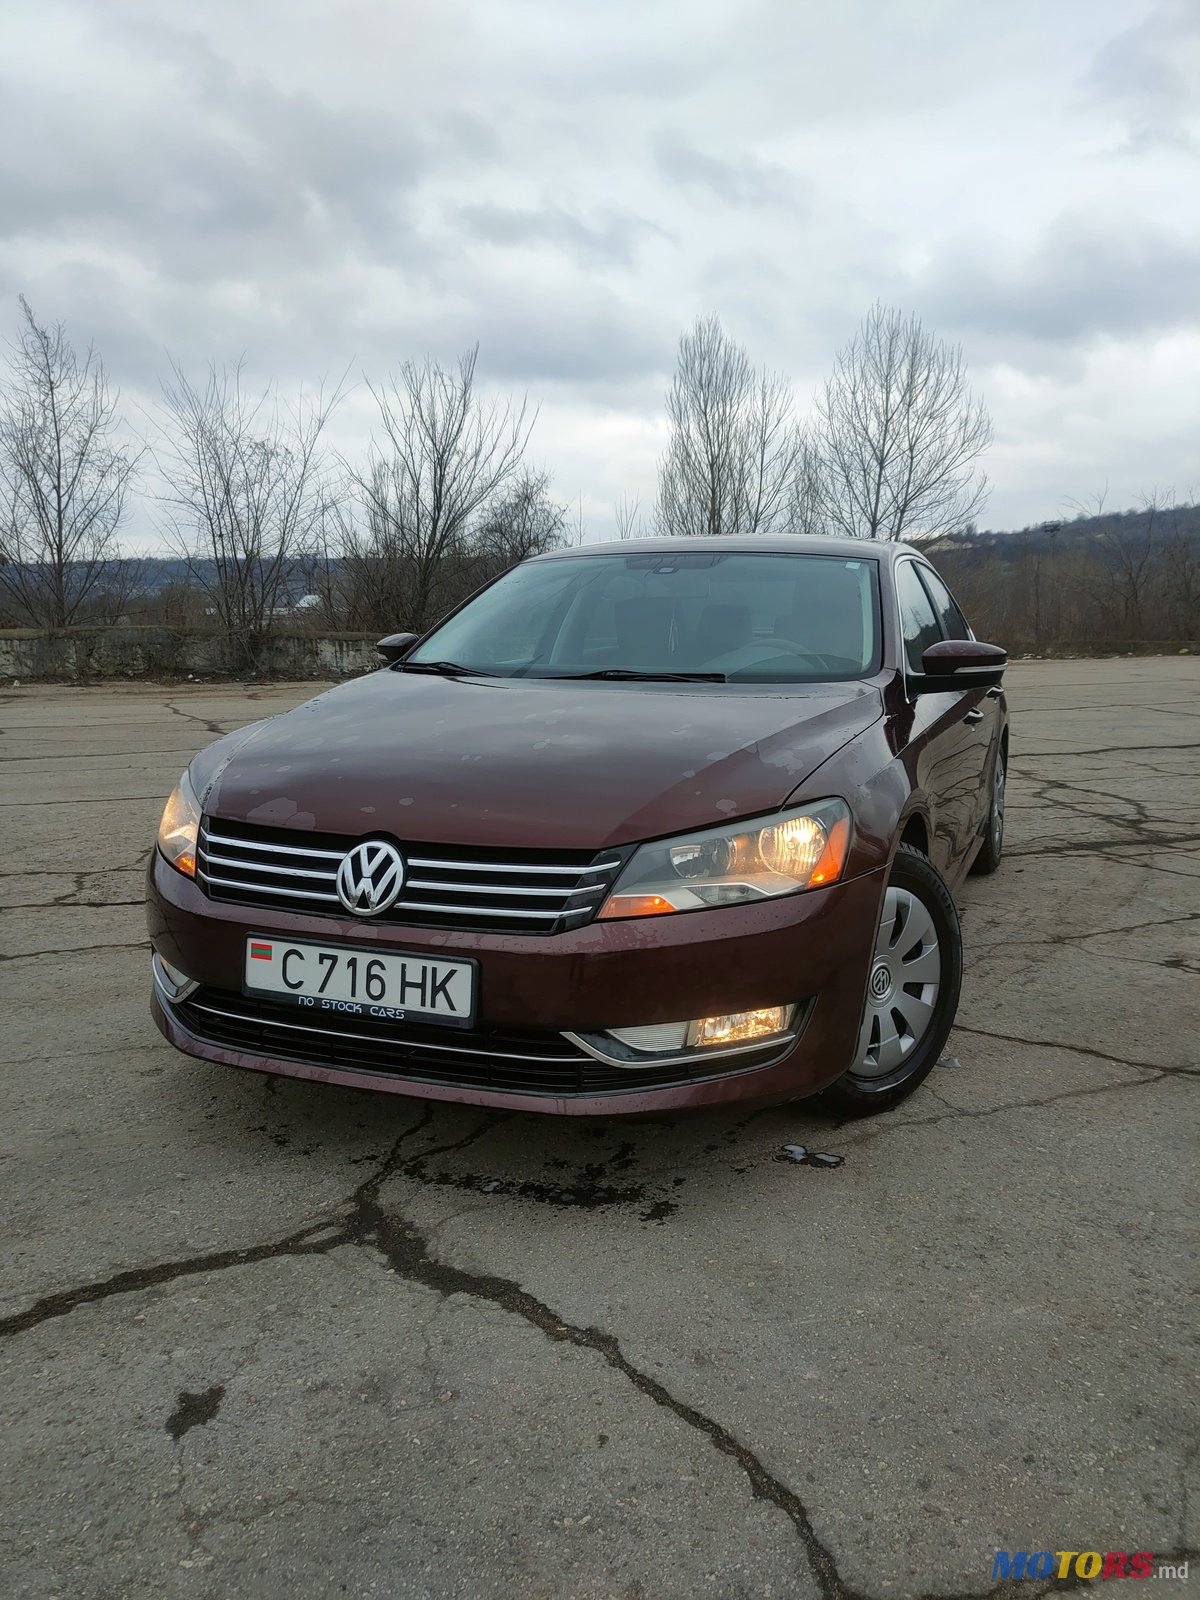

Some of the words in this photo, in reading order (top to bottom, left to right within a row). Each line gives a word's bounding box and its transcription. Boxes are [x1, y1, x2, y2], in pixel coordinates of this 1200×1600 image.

[281, 948, 305, 990] C
[317, 952, 387, 1001] 716
[399, 962, 458, 1012] HK
[321, 999, 362, 1013] STOCK
[370, 1006, 405, 1020] CARS
